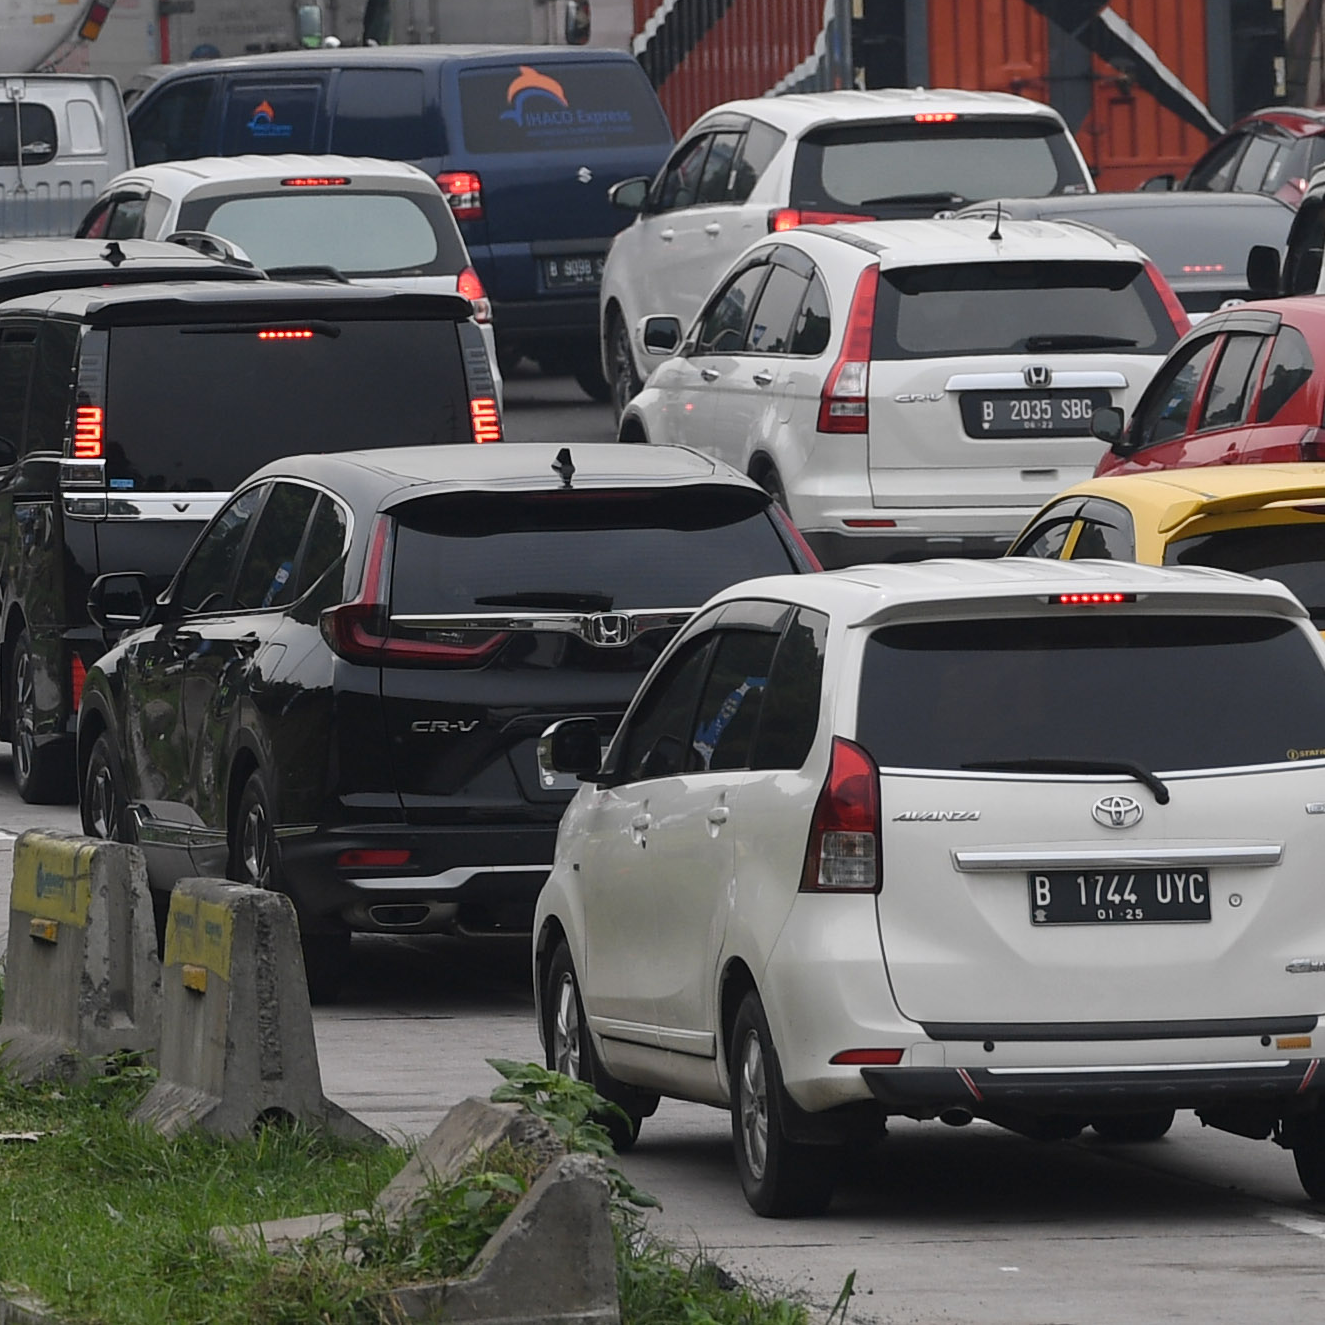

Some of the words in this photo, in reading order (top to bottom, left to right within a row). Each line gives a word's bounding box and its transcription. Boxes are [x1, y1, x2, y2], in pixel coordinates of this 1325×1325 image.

[983, 400, 994, 421] B
[1009, 400, 1052, 420] 2035
[1061, 398, 1093, 420] SBG
[411, 720, 480, 733] CR-V
[892, 810, 981, 822] AVANZA
[1035, 876, 1051, 906] B
[1076, 874, 1138, 905] 1744
[1156, 873, 1206, 904] UYC
